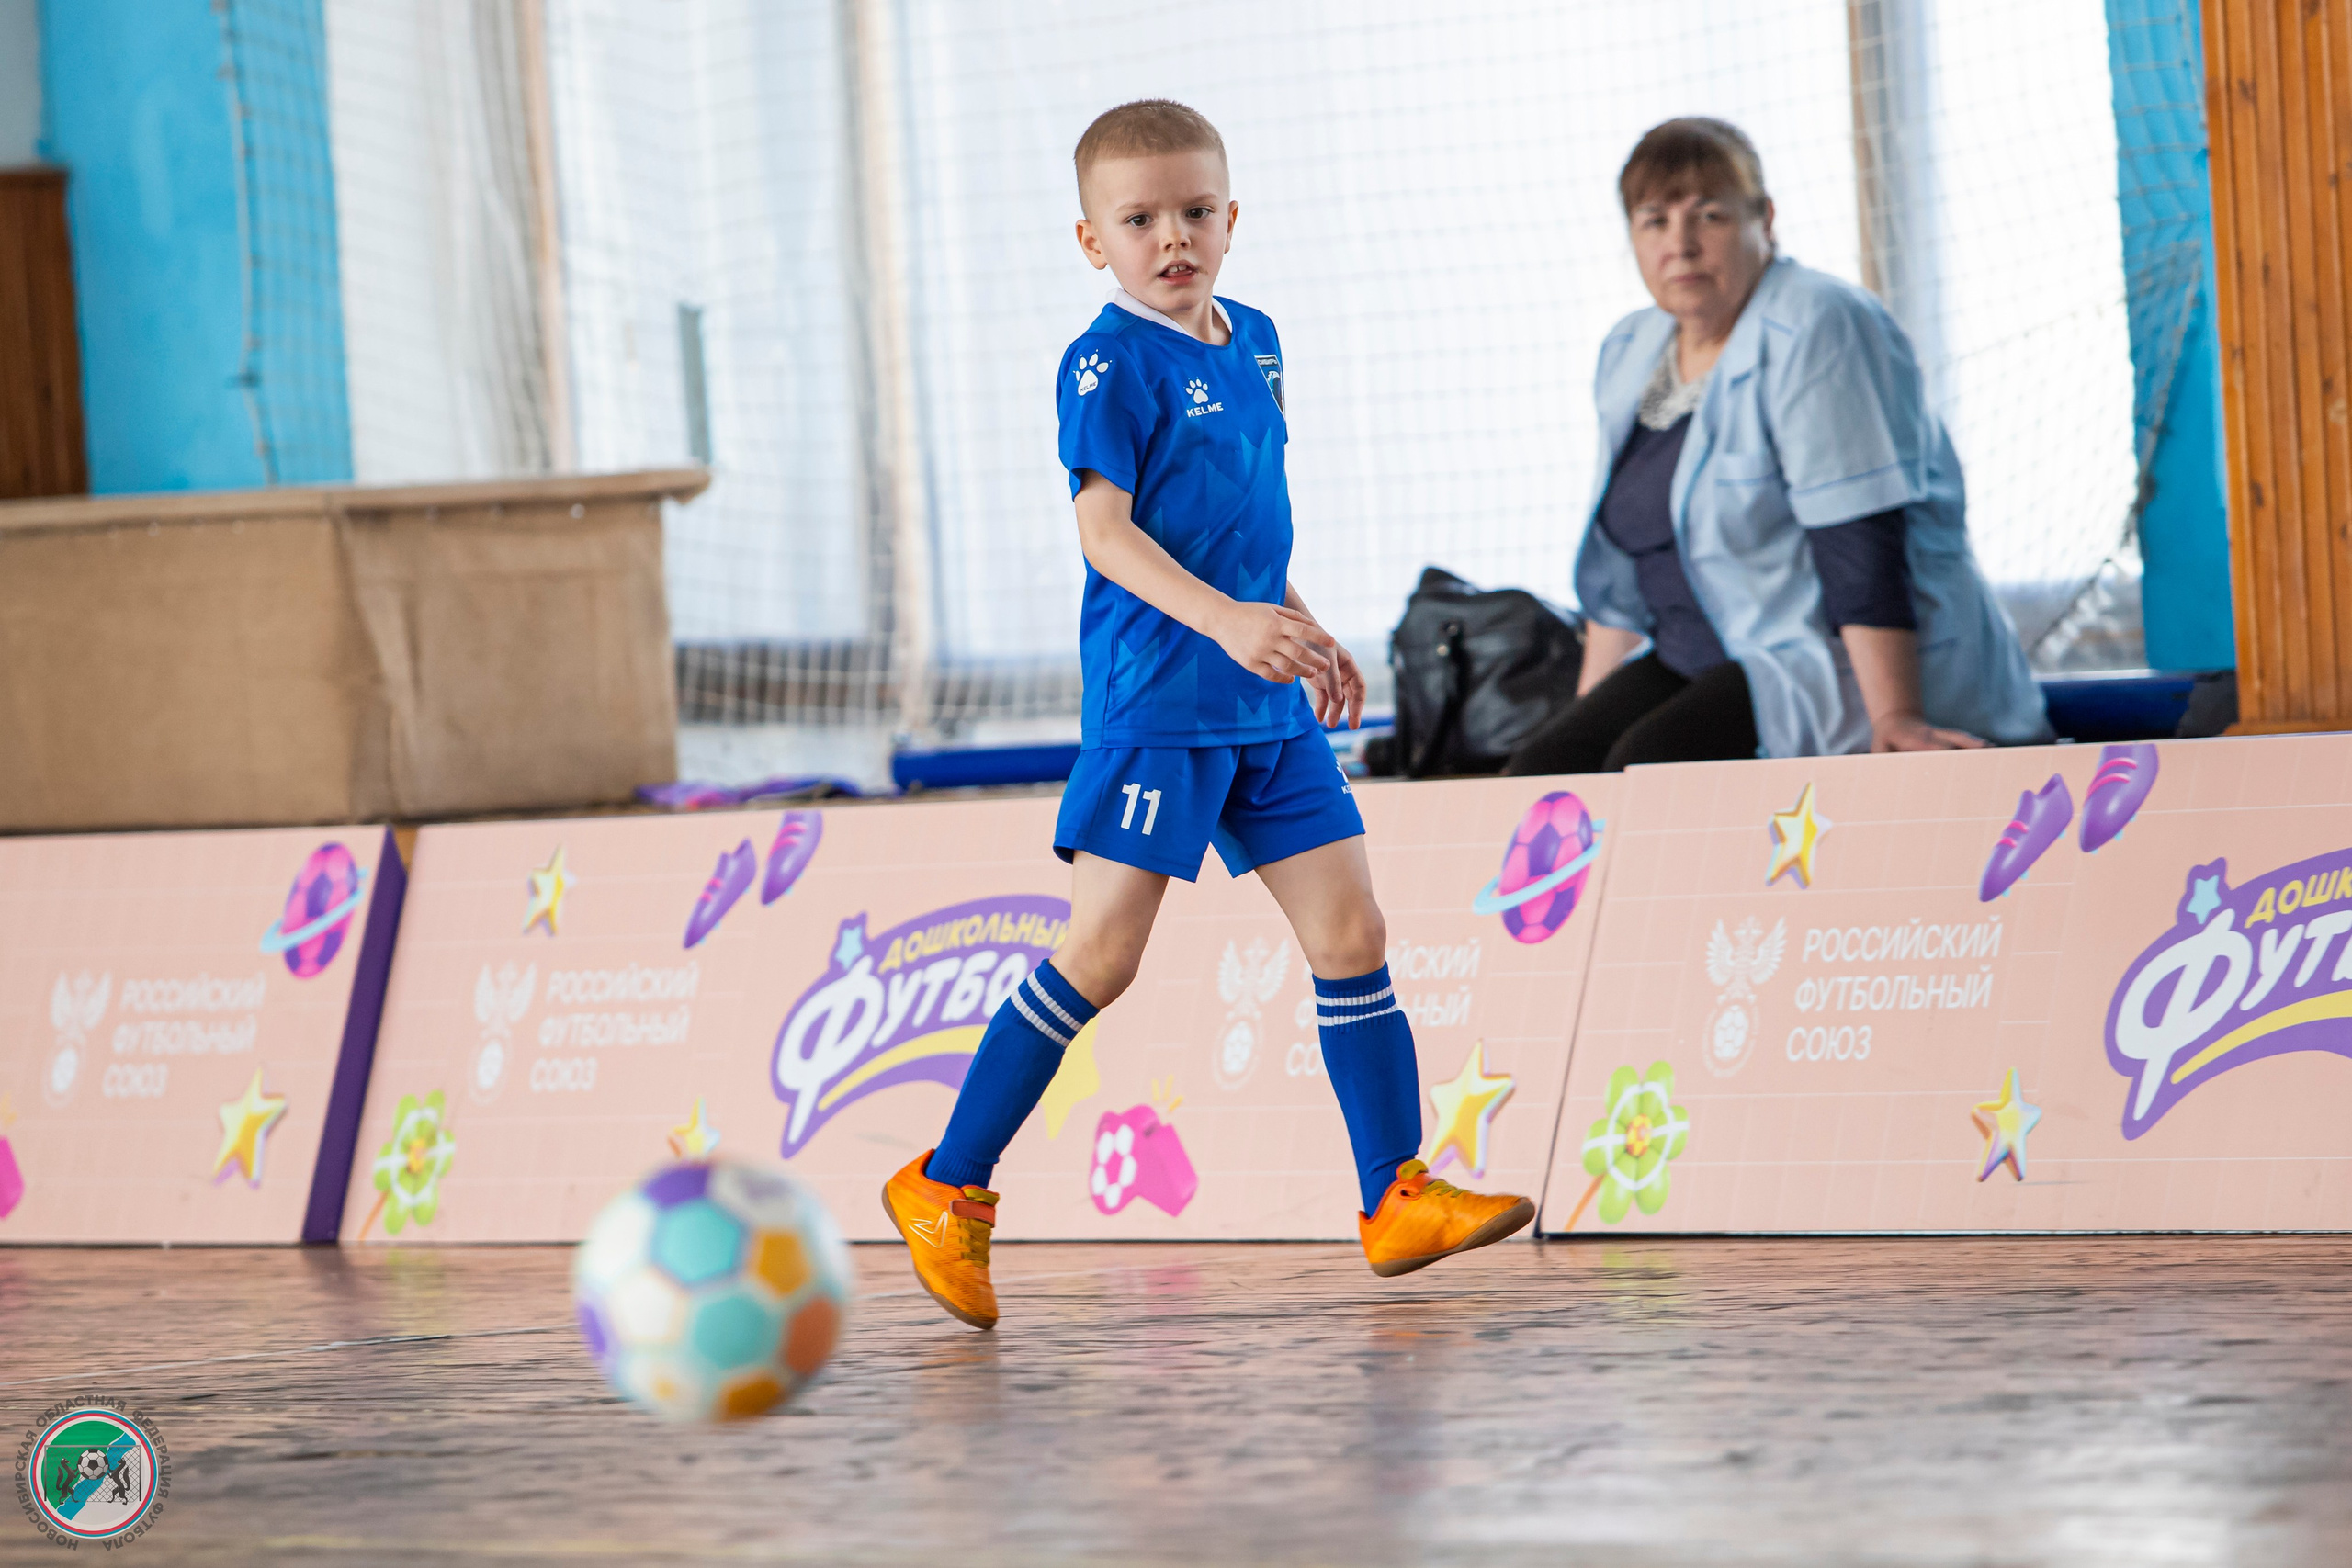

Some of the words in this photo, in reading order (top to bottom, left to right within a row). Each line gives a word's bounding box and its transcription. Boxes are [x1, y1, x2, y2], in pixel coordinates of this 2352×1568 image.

[1186, 402, 1224, 417] KELME
[1121, 783, 1161, 836] 11
[1802, 915, 2003, 962] РОССИЙСКИЙ
[1794, 964, 1995, 1011] ФУТБОЛЬНЫЙ
[777, 949, 1029, 1145] ФУТБО
[1785, 1024, 1872, 1062] СОЮЗ
